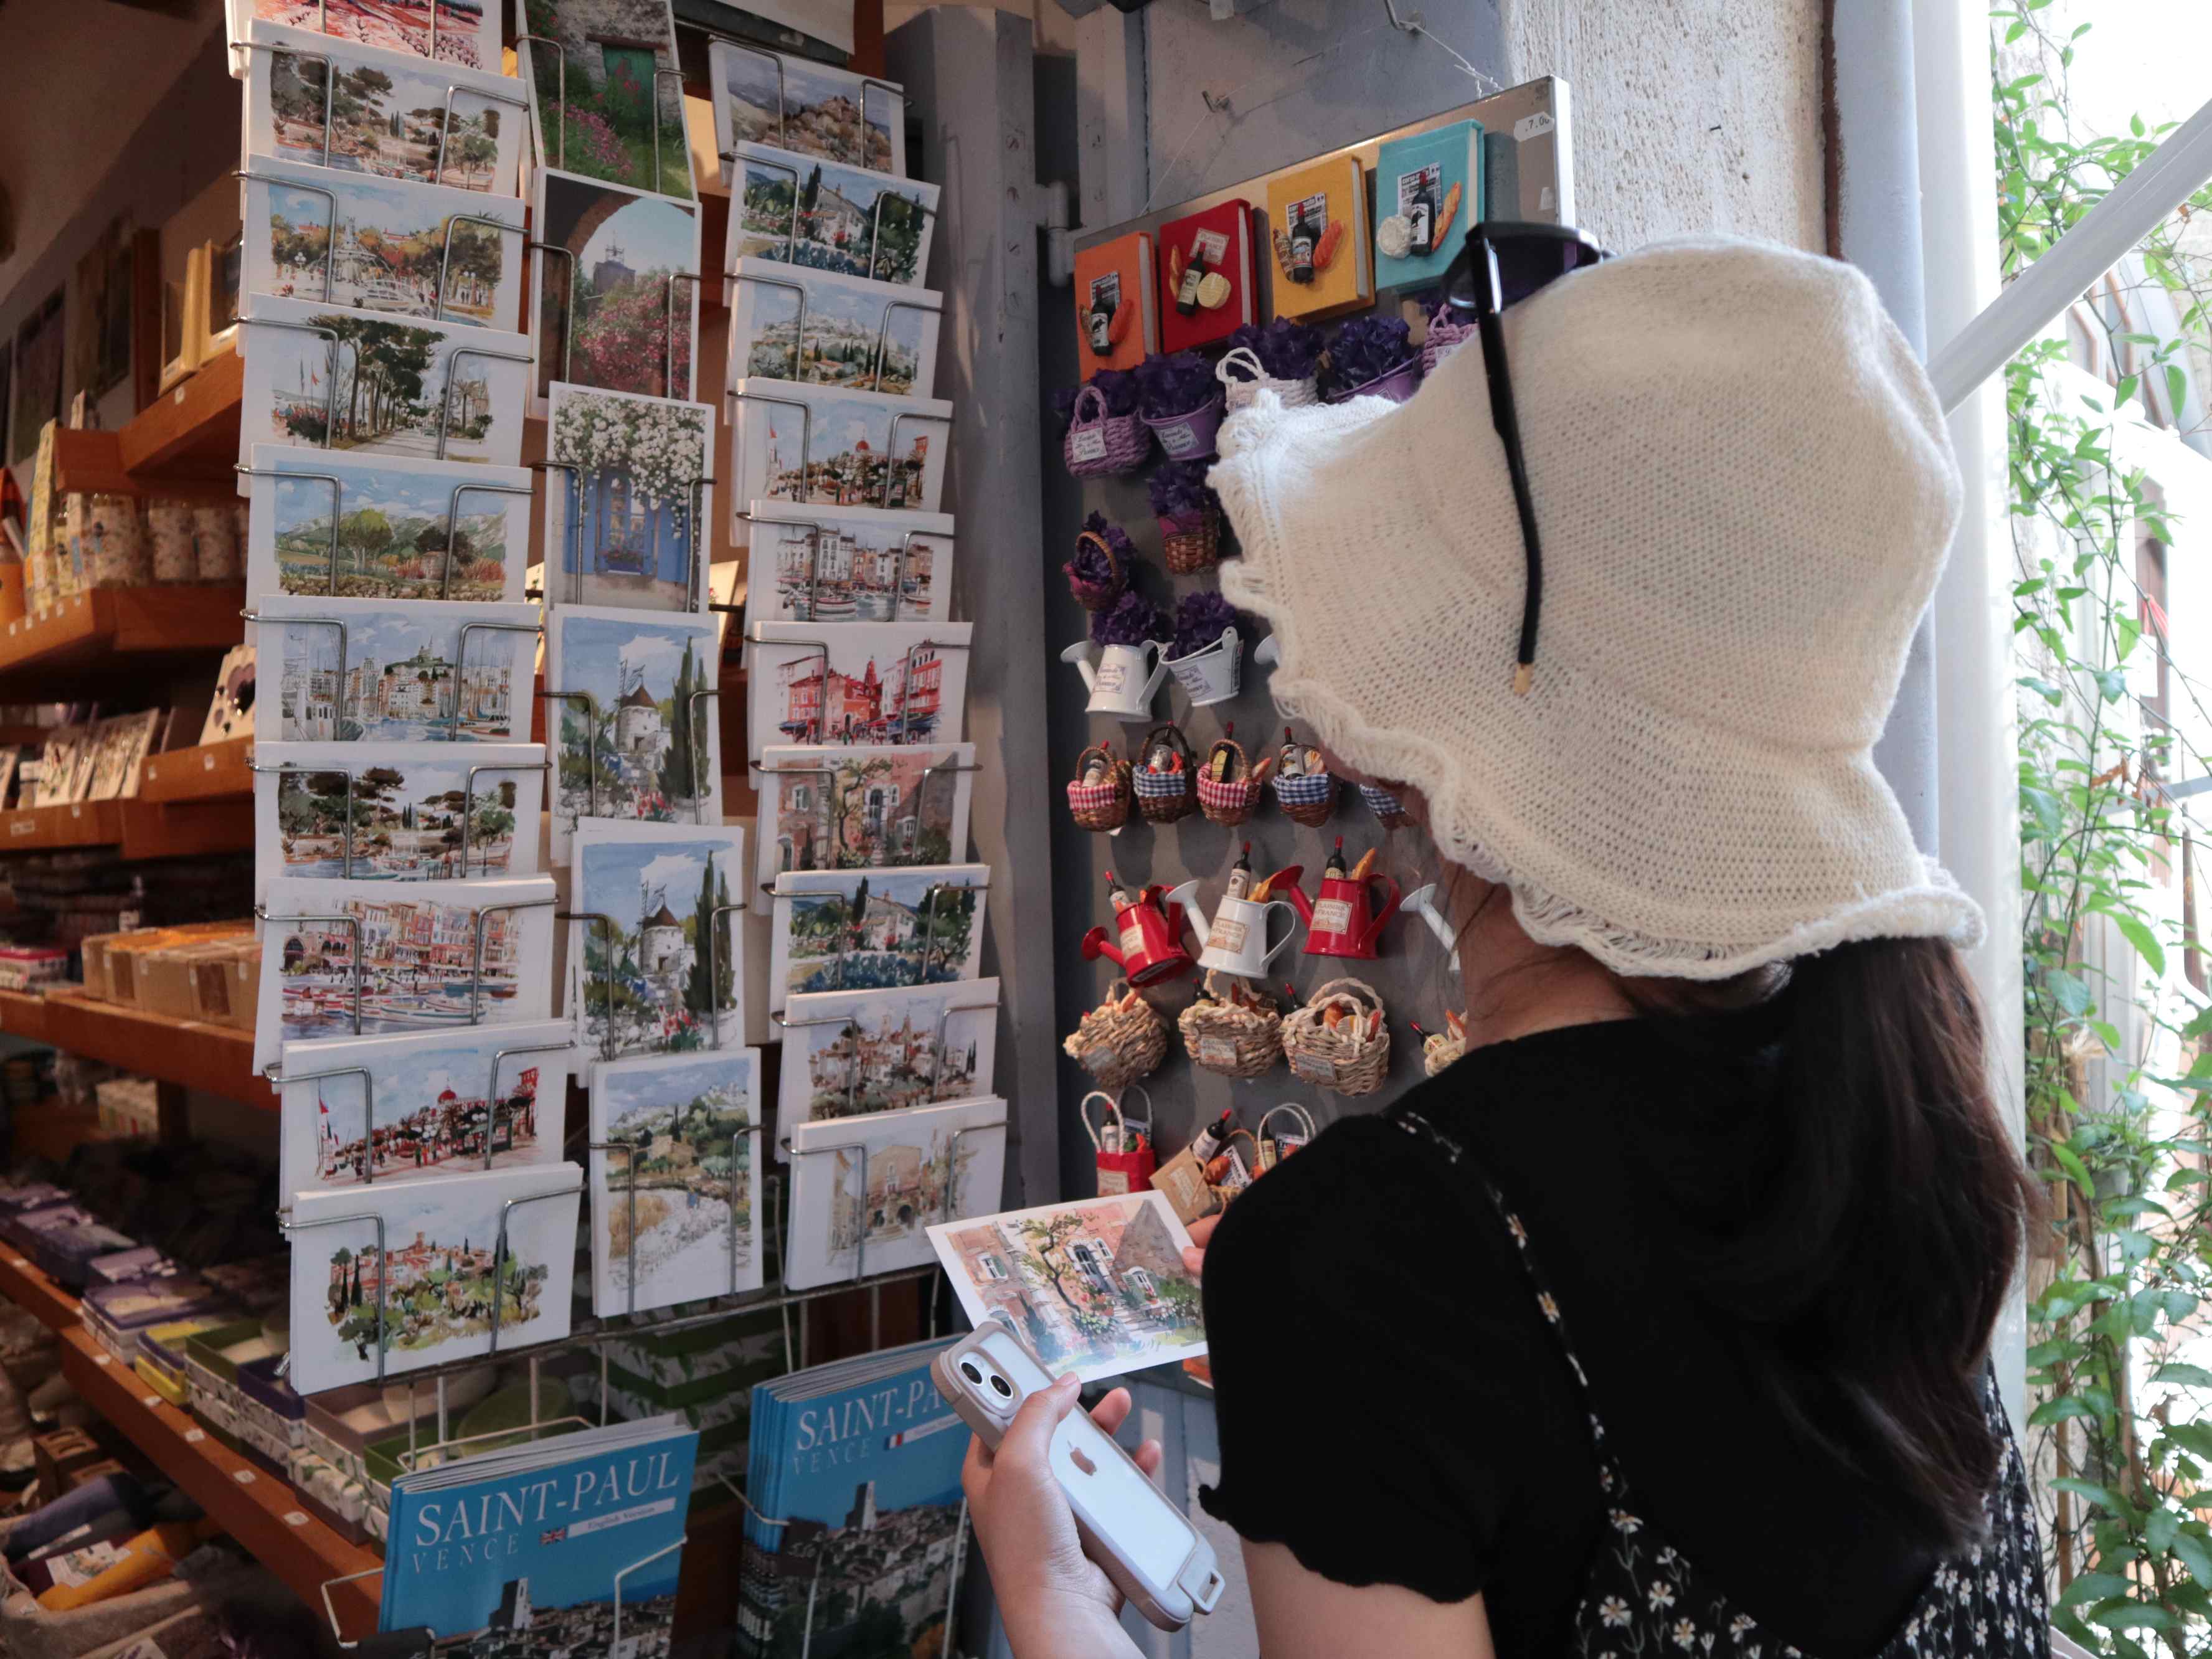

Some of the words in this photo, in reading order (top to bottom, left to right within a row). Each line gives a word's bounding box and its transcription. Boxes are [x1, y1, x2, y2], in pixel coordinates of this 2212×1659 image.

[793, 1437, 871, 1475] VENCE
[415, 1452, 681, 1547] SAINT-PAUL
[413, 1533, 519, 1574] VENCE
